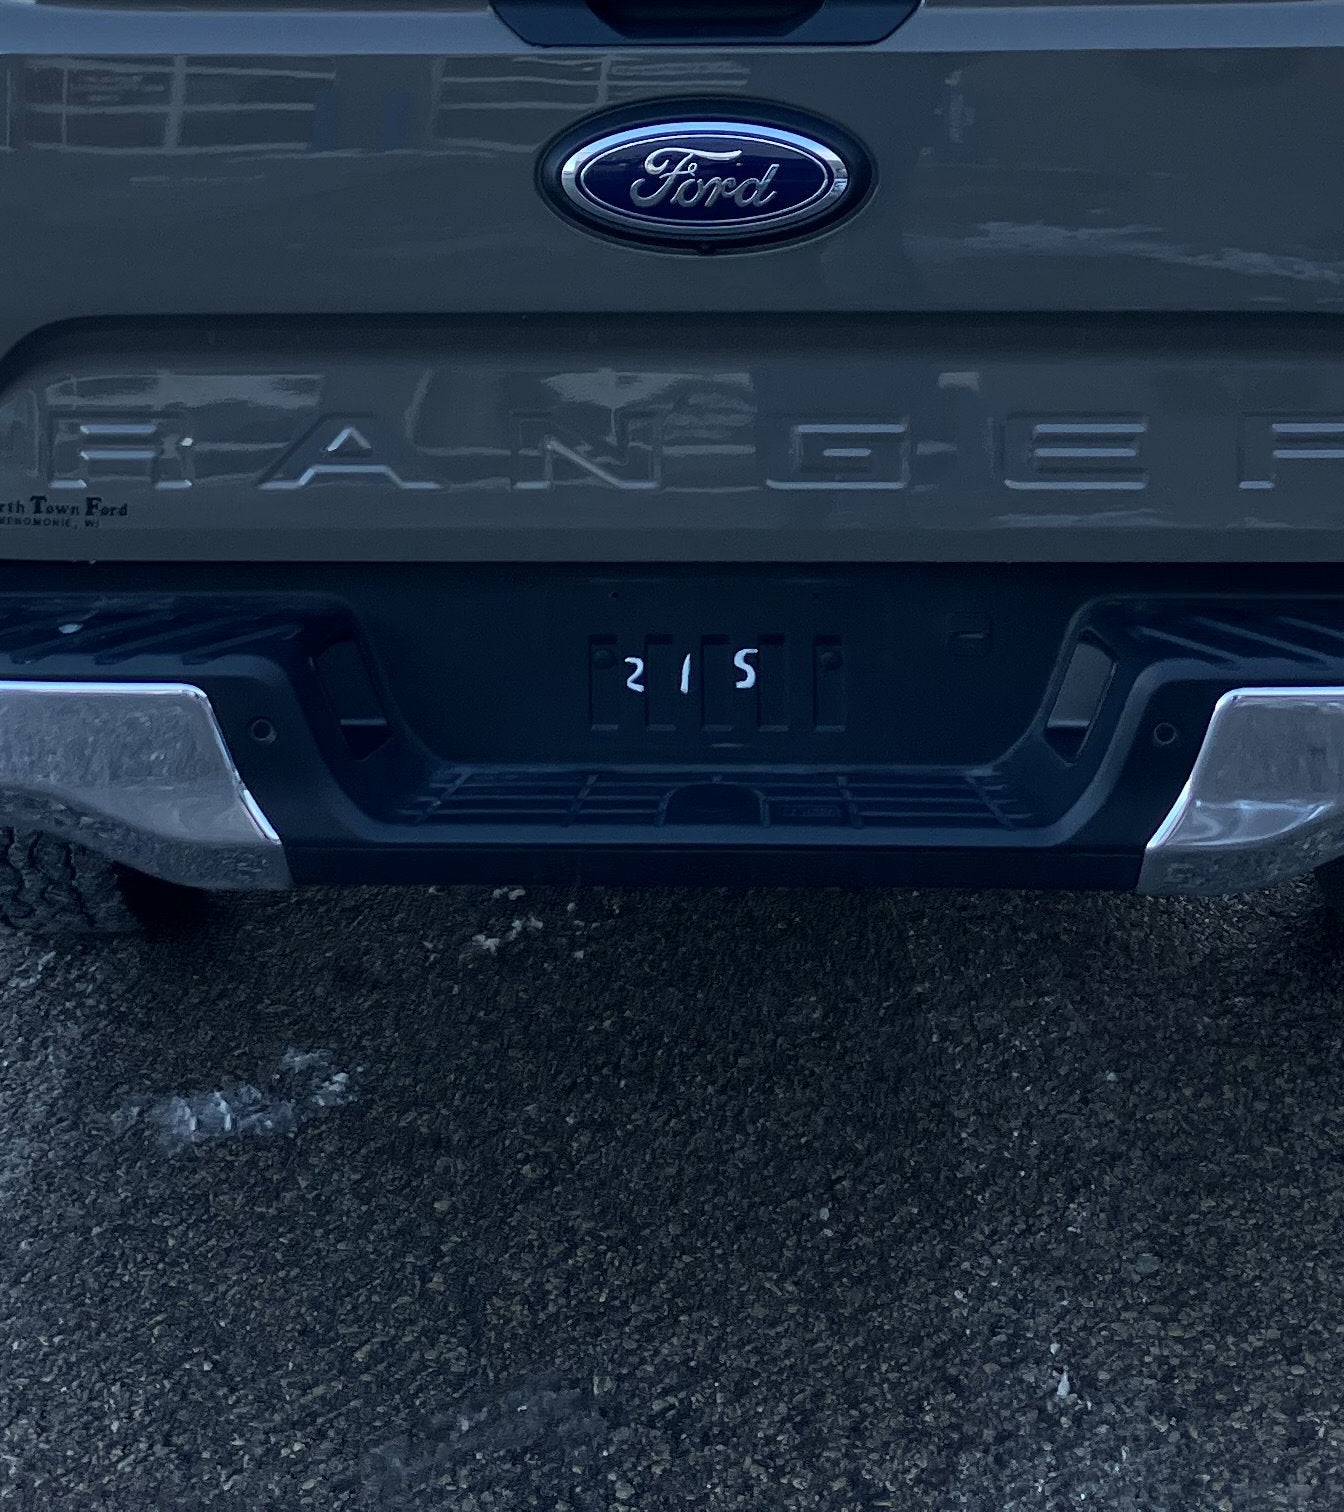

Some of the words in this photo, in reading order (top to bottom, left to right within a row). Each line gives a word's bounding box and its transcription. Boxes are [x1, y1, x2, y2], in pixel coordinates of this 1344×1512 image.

[629, 147, 779, 207] Ford
[30, 495, 80, 515] Town
[85, 496, 128, 516] Ford
